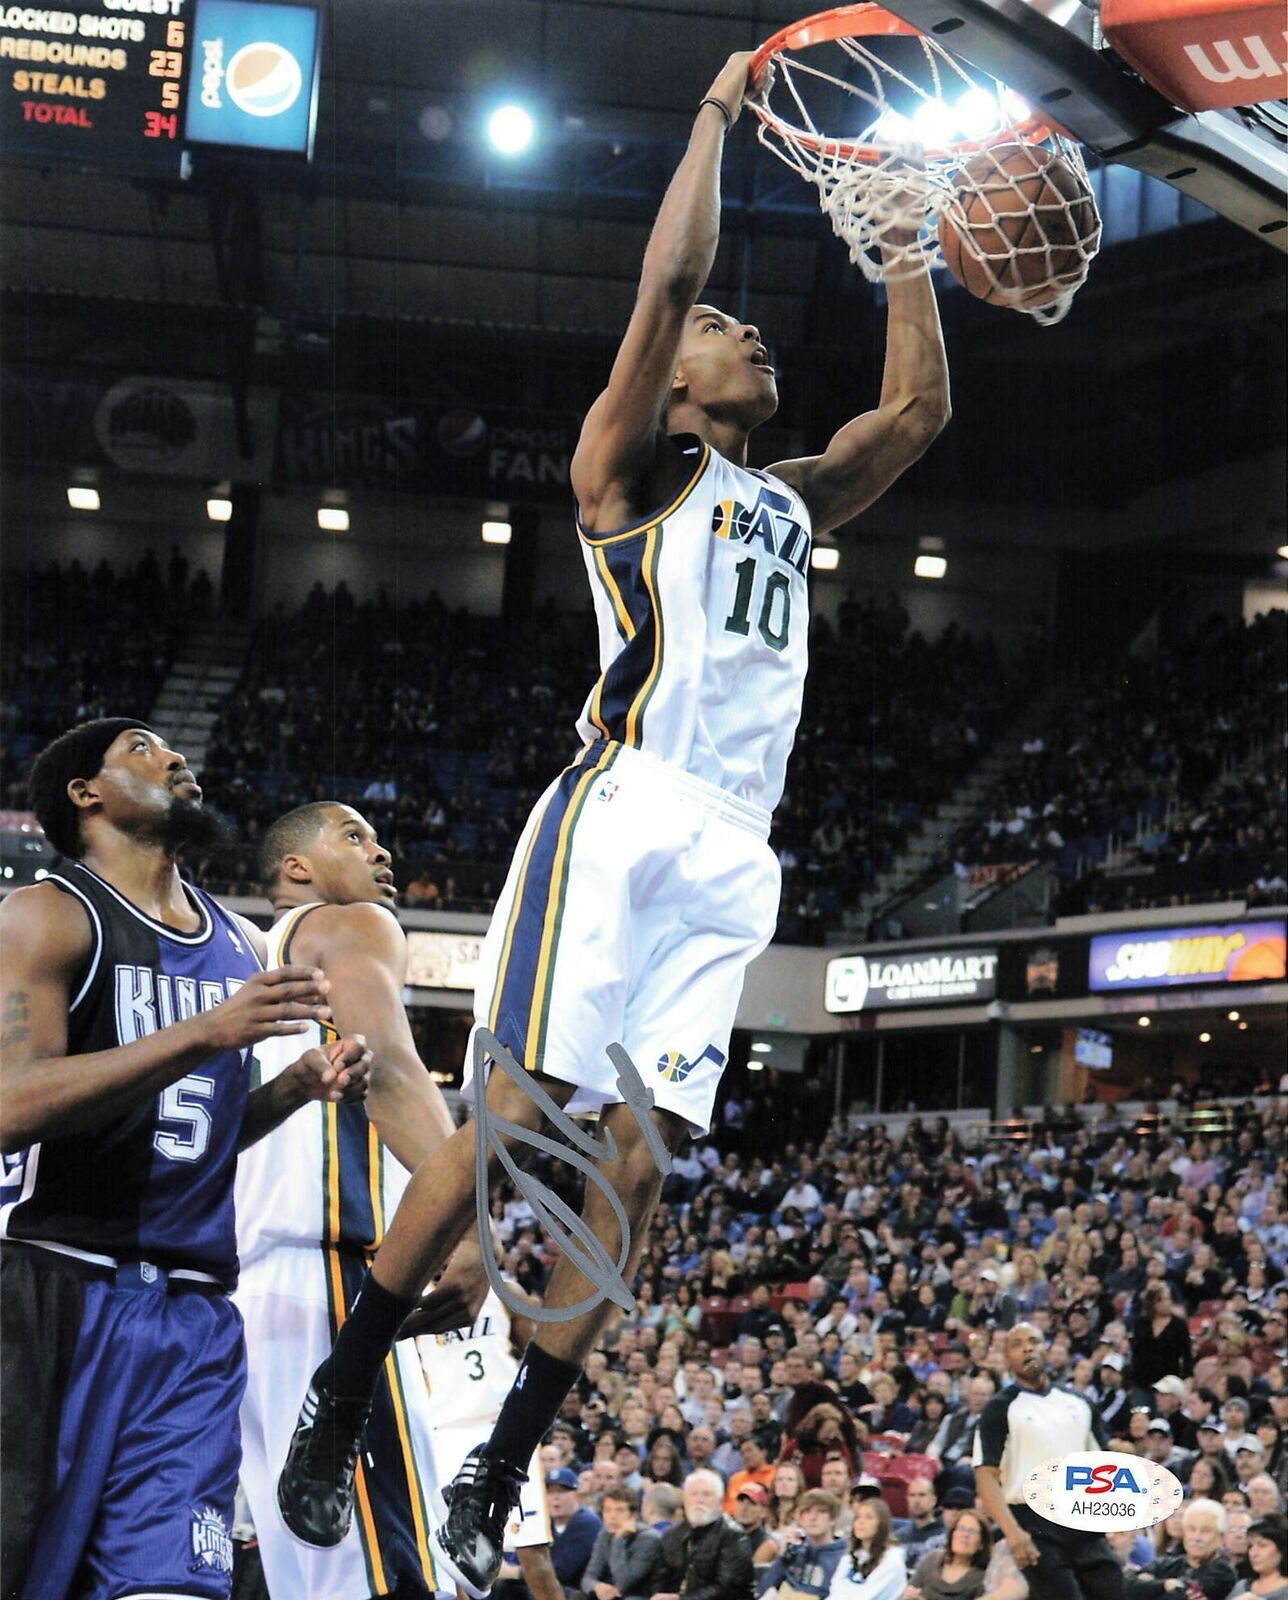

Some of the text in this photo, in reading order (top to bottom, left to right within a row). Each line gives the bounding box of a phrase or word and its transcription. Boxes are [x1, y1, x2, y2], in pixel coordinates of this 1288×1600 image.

[78, 14, 145, 42] SHOTS
[166, 20, 185, 48] 6
[0, 36, 183, 79] REBOUNDS 23
[201, 38, 223, 109] pepsi
[13, 70, 180, 110] STEALS 5
[21, 102, 177, 140] TOTAL 34
[724, 556, 791, 653] 10
[1105, 932, 1246, 982] SUBWAY
[115, 964, 246, 1046] KING
[153, 1073, 215, 1164] 5
[465, 1349, 485, 1381] 3
